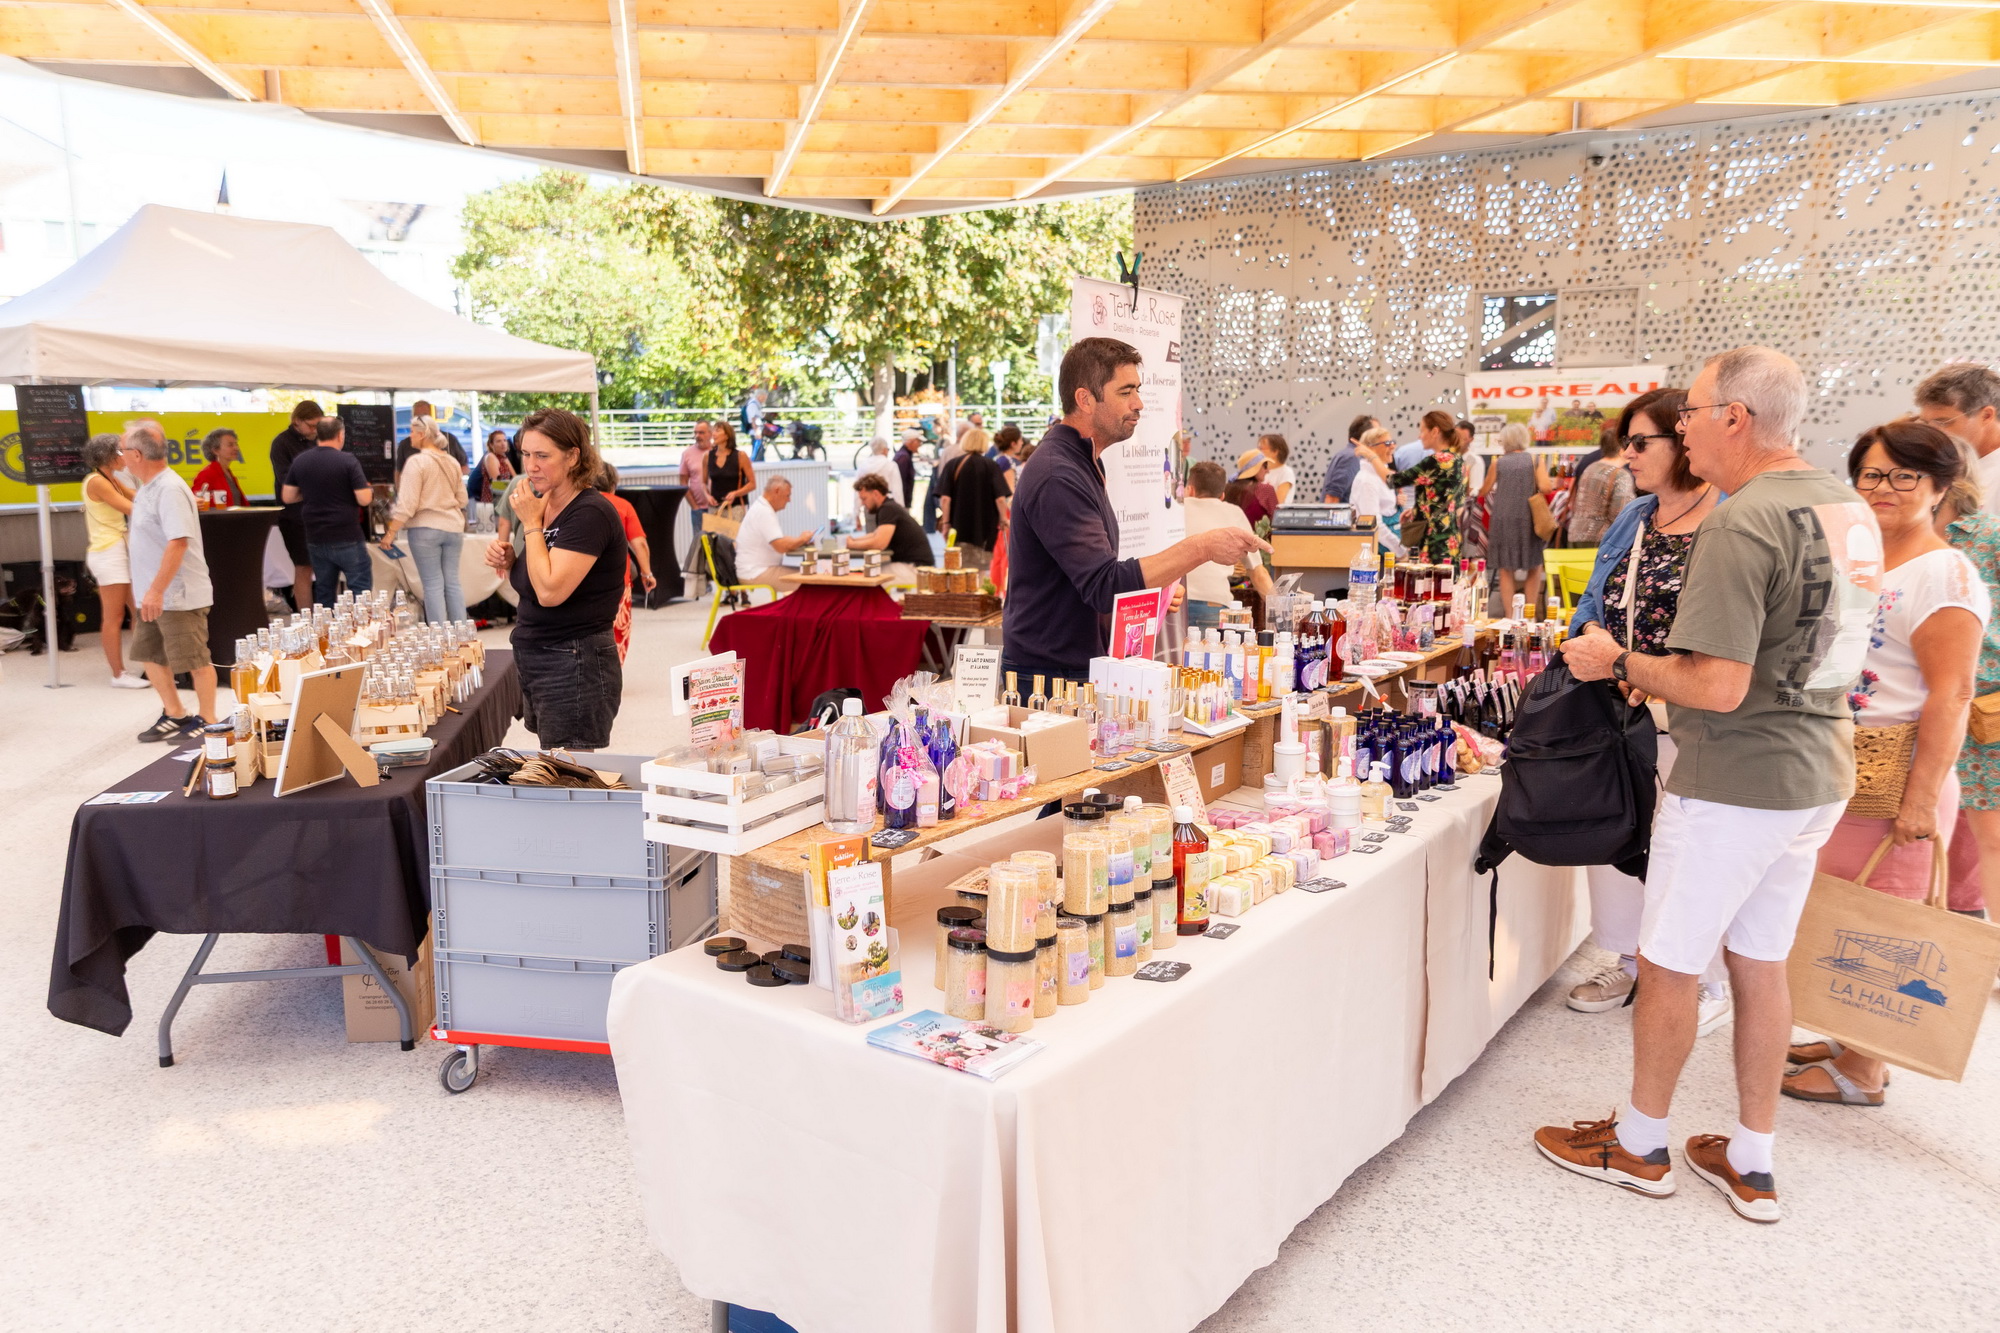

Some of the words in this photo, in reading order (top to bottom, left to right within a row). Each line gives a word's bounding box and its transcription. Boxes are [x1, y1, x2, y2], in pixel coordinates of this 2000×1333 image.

[1109, 292, 1139, 321] Terre
[1149, 297, 1176, 326] Rose
[1471, 381, 1659, 399] MOREAU
[1122, 444, 1131, 458] La
[1131, 444, 1161, 458] Distillerie
[858, 871, 877, 880] Rose
[1829, 978, 1854, 999] LA
[1858, 988, 1923, 1020] HALLE
[1840, 998, 1905, 1023] SAINT-AVERTIN
